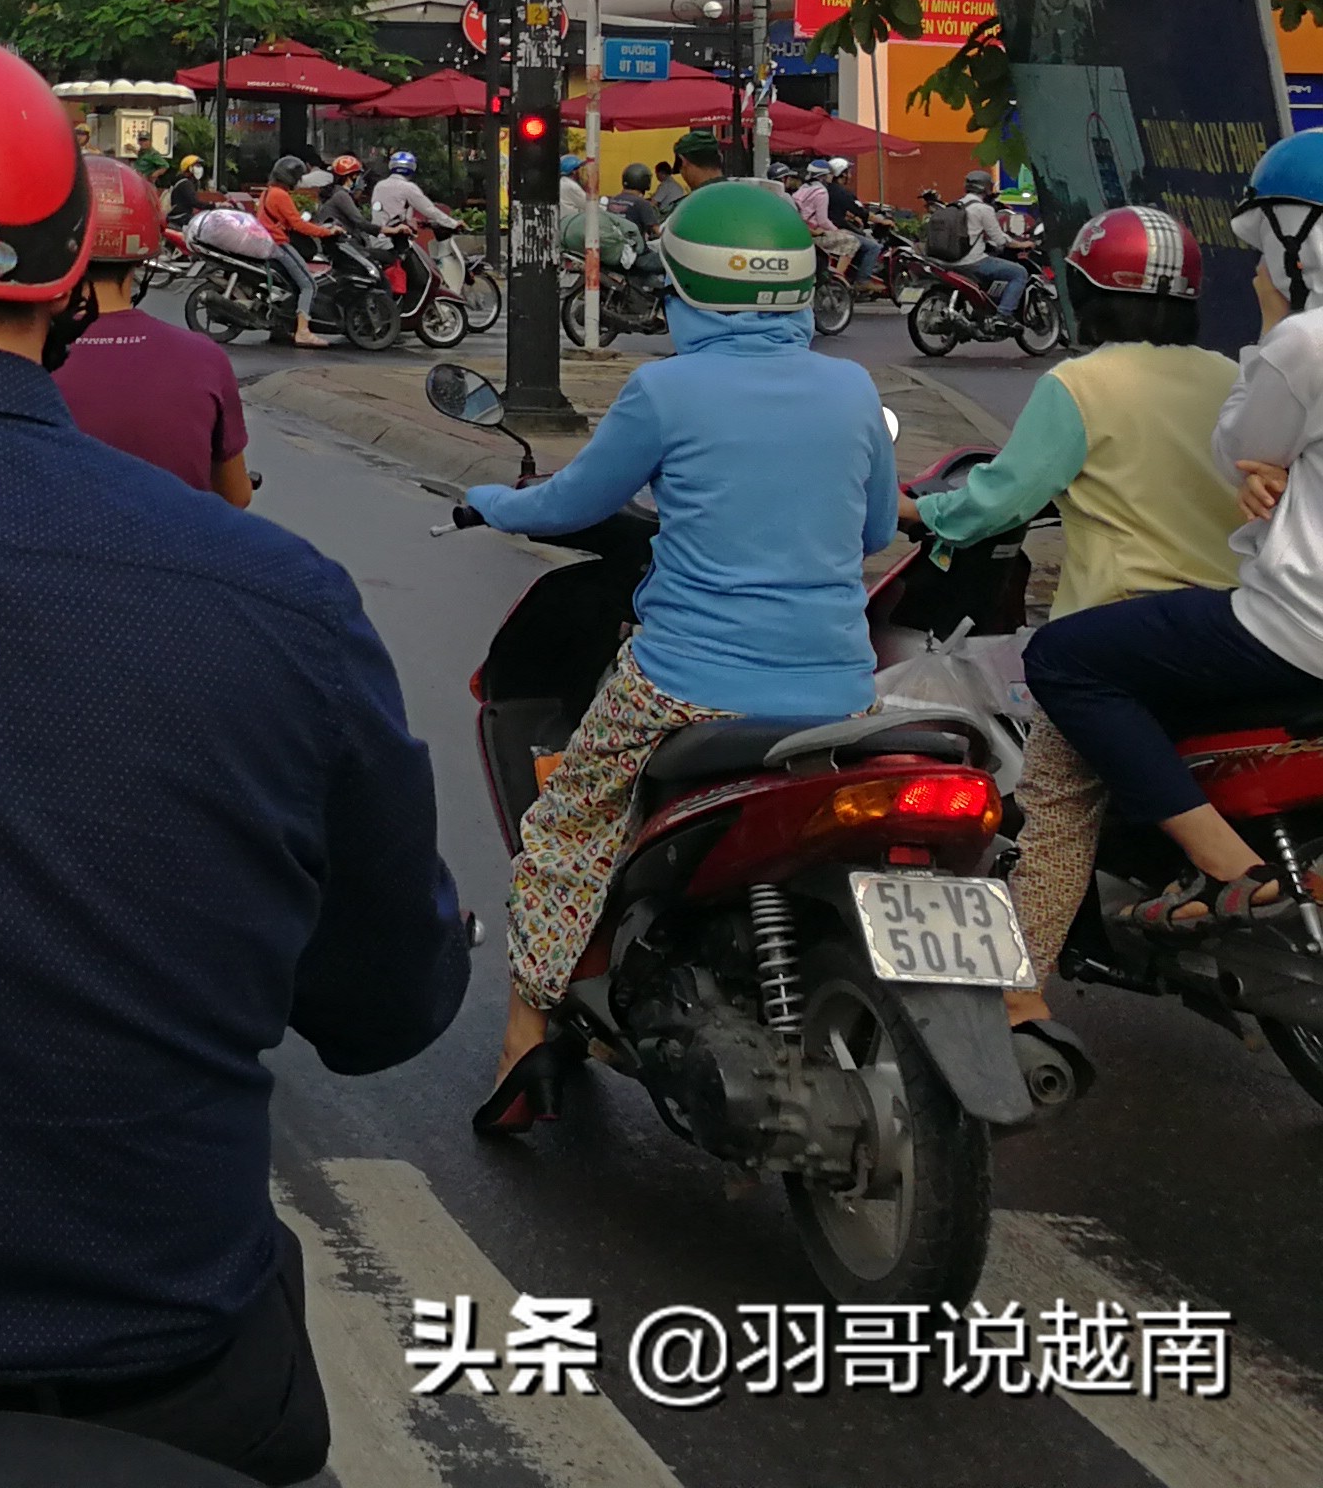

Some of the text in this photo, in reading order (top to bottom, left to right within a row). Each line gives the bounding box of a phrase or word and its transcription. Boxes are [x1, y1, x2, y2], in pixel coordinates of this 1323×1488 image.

[931, 0, 960, 14] MINH
[962, 1, 997, 17] CHUN
[620, 43, 657, 56] ĐƯỜNG
[749, 257, 790, 271] OCB
[876, 882, 993, 928] 54-V3
[888, 928, 1003, 977] 5041
